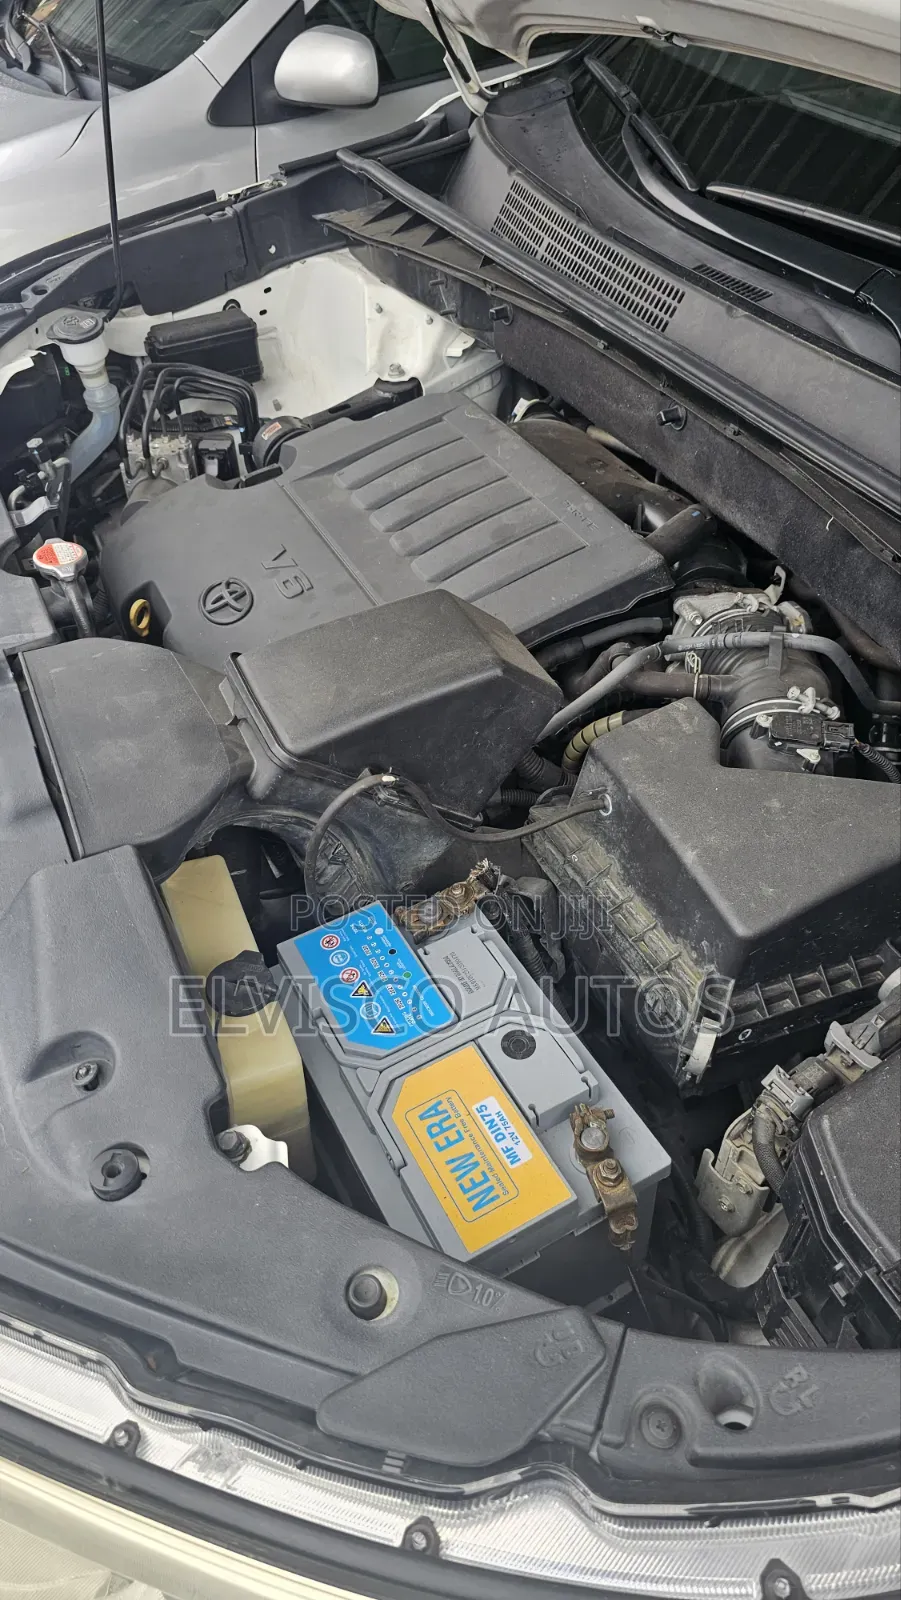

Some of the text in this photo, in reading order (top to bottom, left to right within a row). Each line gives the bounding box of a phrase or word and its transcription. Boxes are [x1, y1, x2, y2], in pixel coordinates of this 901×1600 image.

[261, 543, 314, 600] V6
[418, 1100, 500, 1212] NEW ERA
[444, 1096, 510, 1196] Sealed Maintenance Free Battery
[475, 1103, 521, 1166] MF DIN75
[495, 1110, 521, 1146] 12V 75AH
